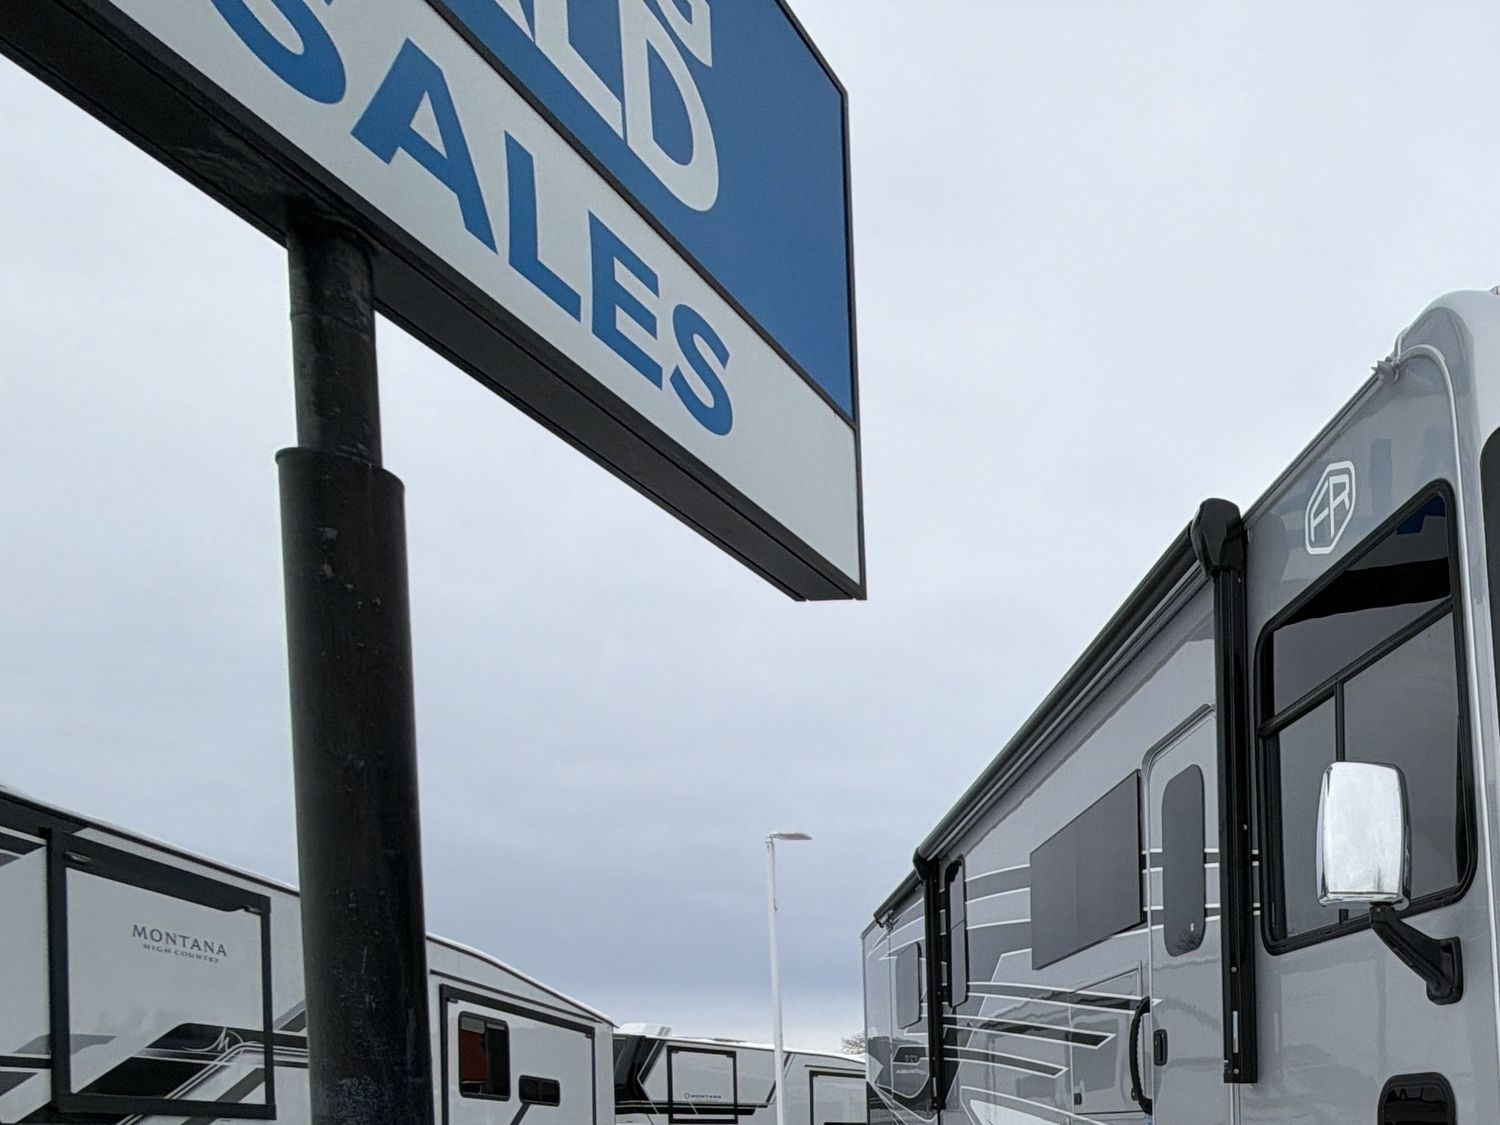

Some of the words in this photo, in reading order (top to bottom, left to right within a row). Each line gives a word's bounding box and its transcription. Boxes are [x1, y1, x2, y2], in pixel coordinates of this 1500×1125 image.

[132, 924, 228, 957] MONTANA
[143, 943, 172, 955] HIGH
[174, 948, 220, 963] COUNTRY
